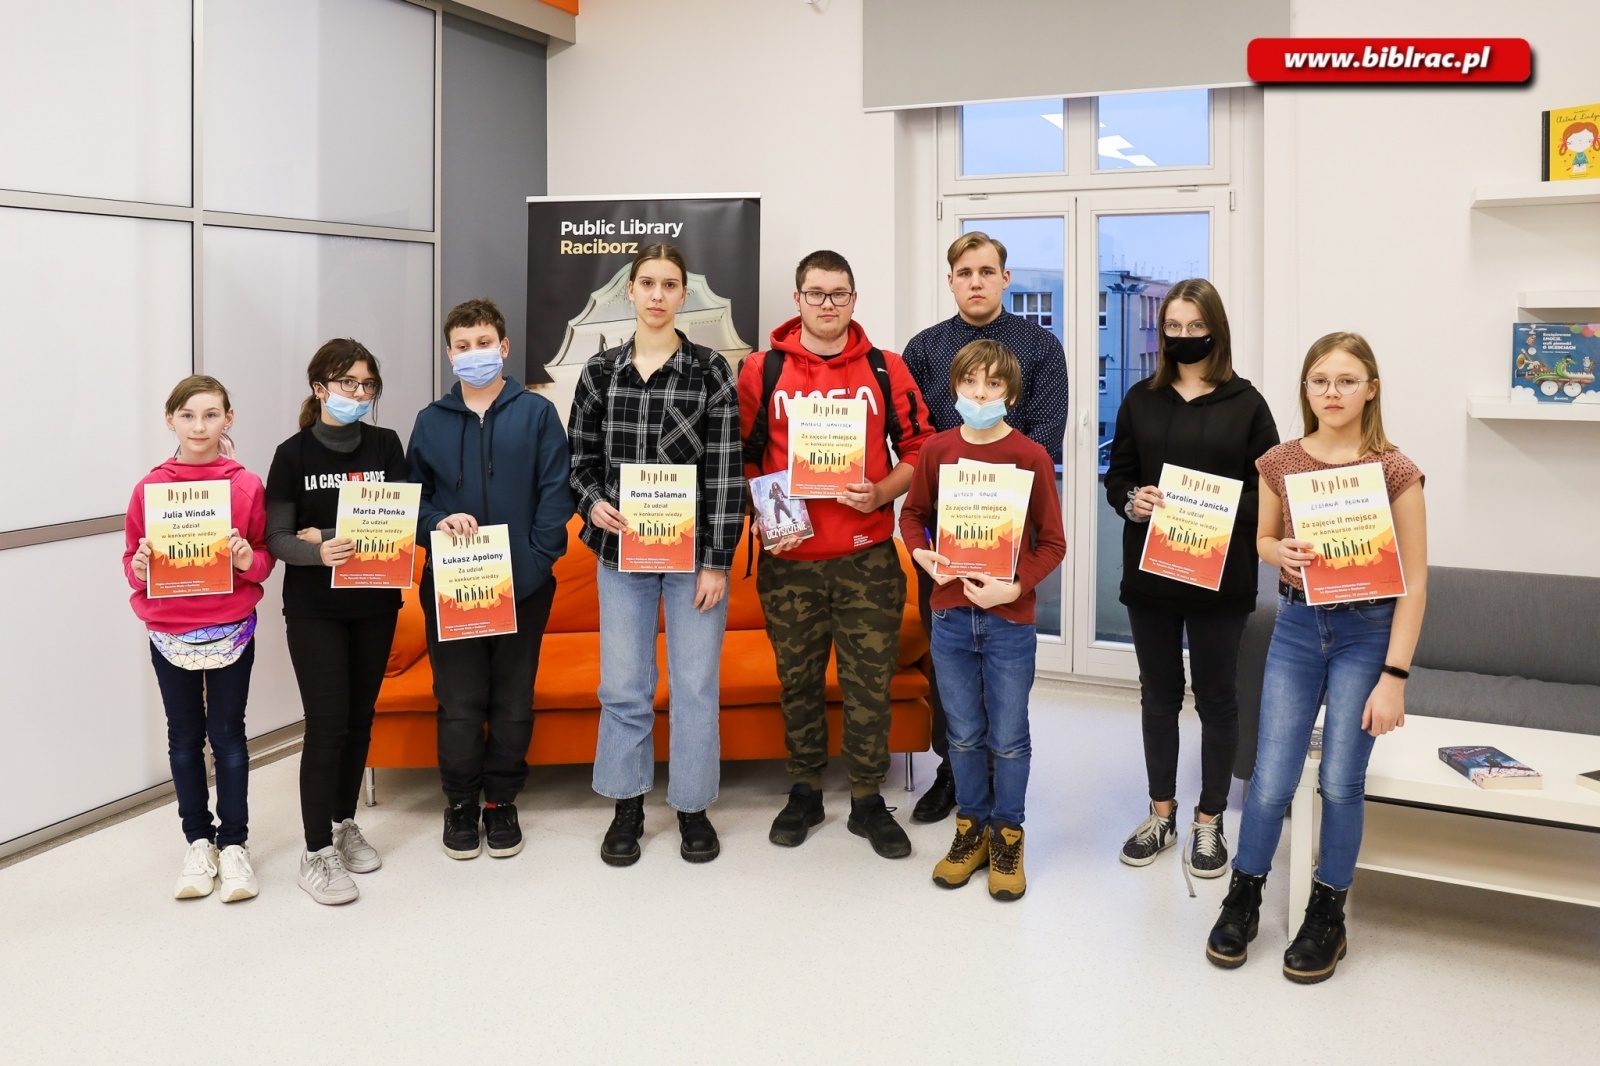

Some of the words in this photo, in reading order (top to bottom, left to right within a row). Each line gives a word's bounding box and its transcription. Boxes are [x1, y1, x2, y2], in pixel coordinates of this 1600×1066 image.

[560, 219, 616, 236] Public
[620, 219, 683, 238] Library
[560, 238, 638, 254] Raciborz
[813, 403, 848, 416] Dyplom
[304, 475, 318, 490] LA
[319, 473, 348, 489] CASA
[641, 470, 677, 484] Dyplom
[959, 470, 996, 484] Dyplom
[1182, 474, 1220, 494] Dyplom
[1311, 476, 1359, 495] Dyplom
[168, 488, 209, 503] Dyplom
[361, 487, 400, 501] Dyplom
[1166, 491, 1198, 505] Karolina
[1199, 500, 1229, 513] Janicka
[162, 511, 182, 519] Julia
[185, 509, 216, 517] Windak
[1187, 510, 1204, 519] udział
[1312, 519, 1336, 528] zajęcie
[1345, 513, 1377, 523] miejsca
[1172, 515, 1198, 525] konkursie
[1200, 522, 1218, 531] wiedzy
[1320, 527, 1351, 535] konkursie
[453, 533, 489, 549] Dyplom
[442, 556, 470, 564] Łukasz
[472, 553, 503, 562] Apolony
